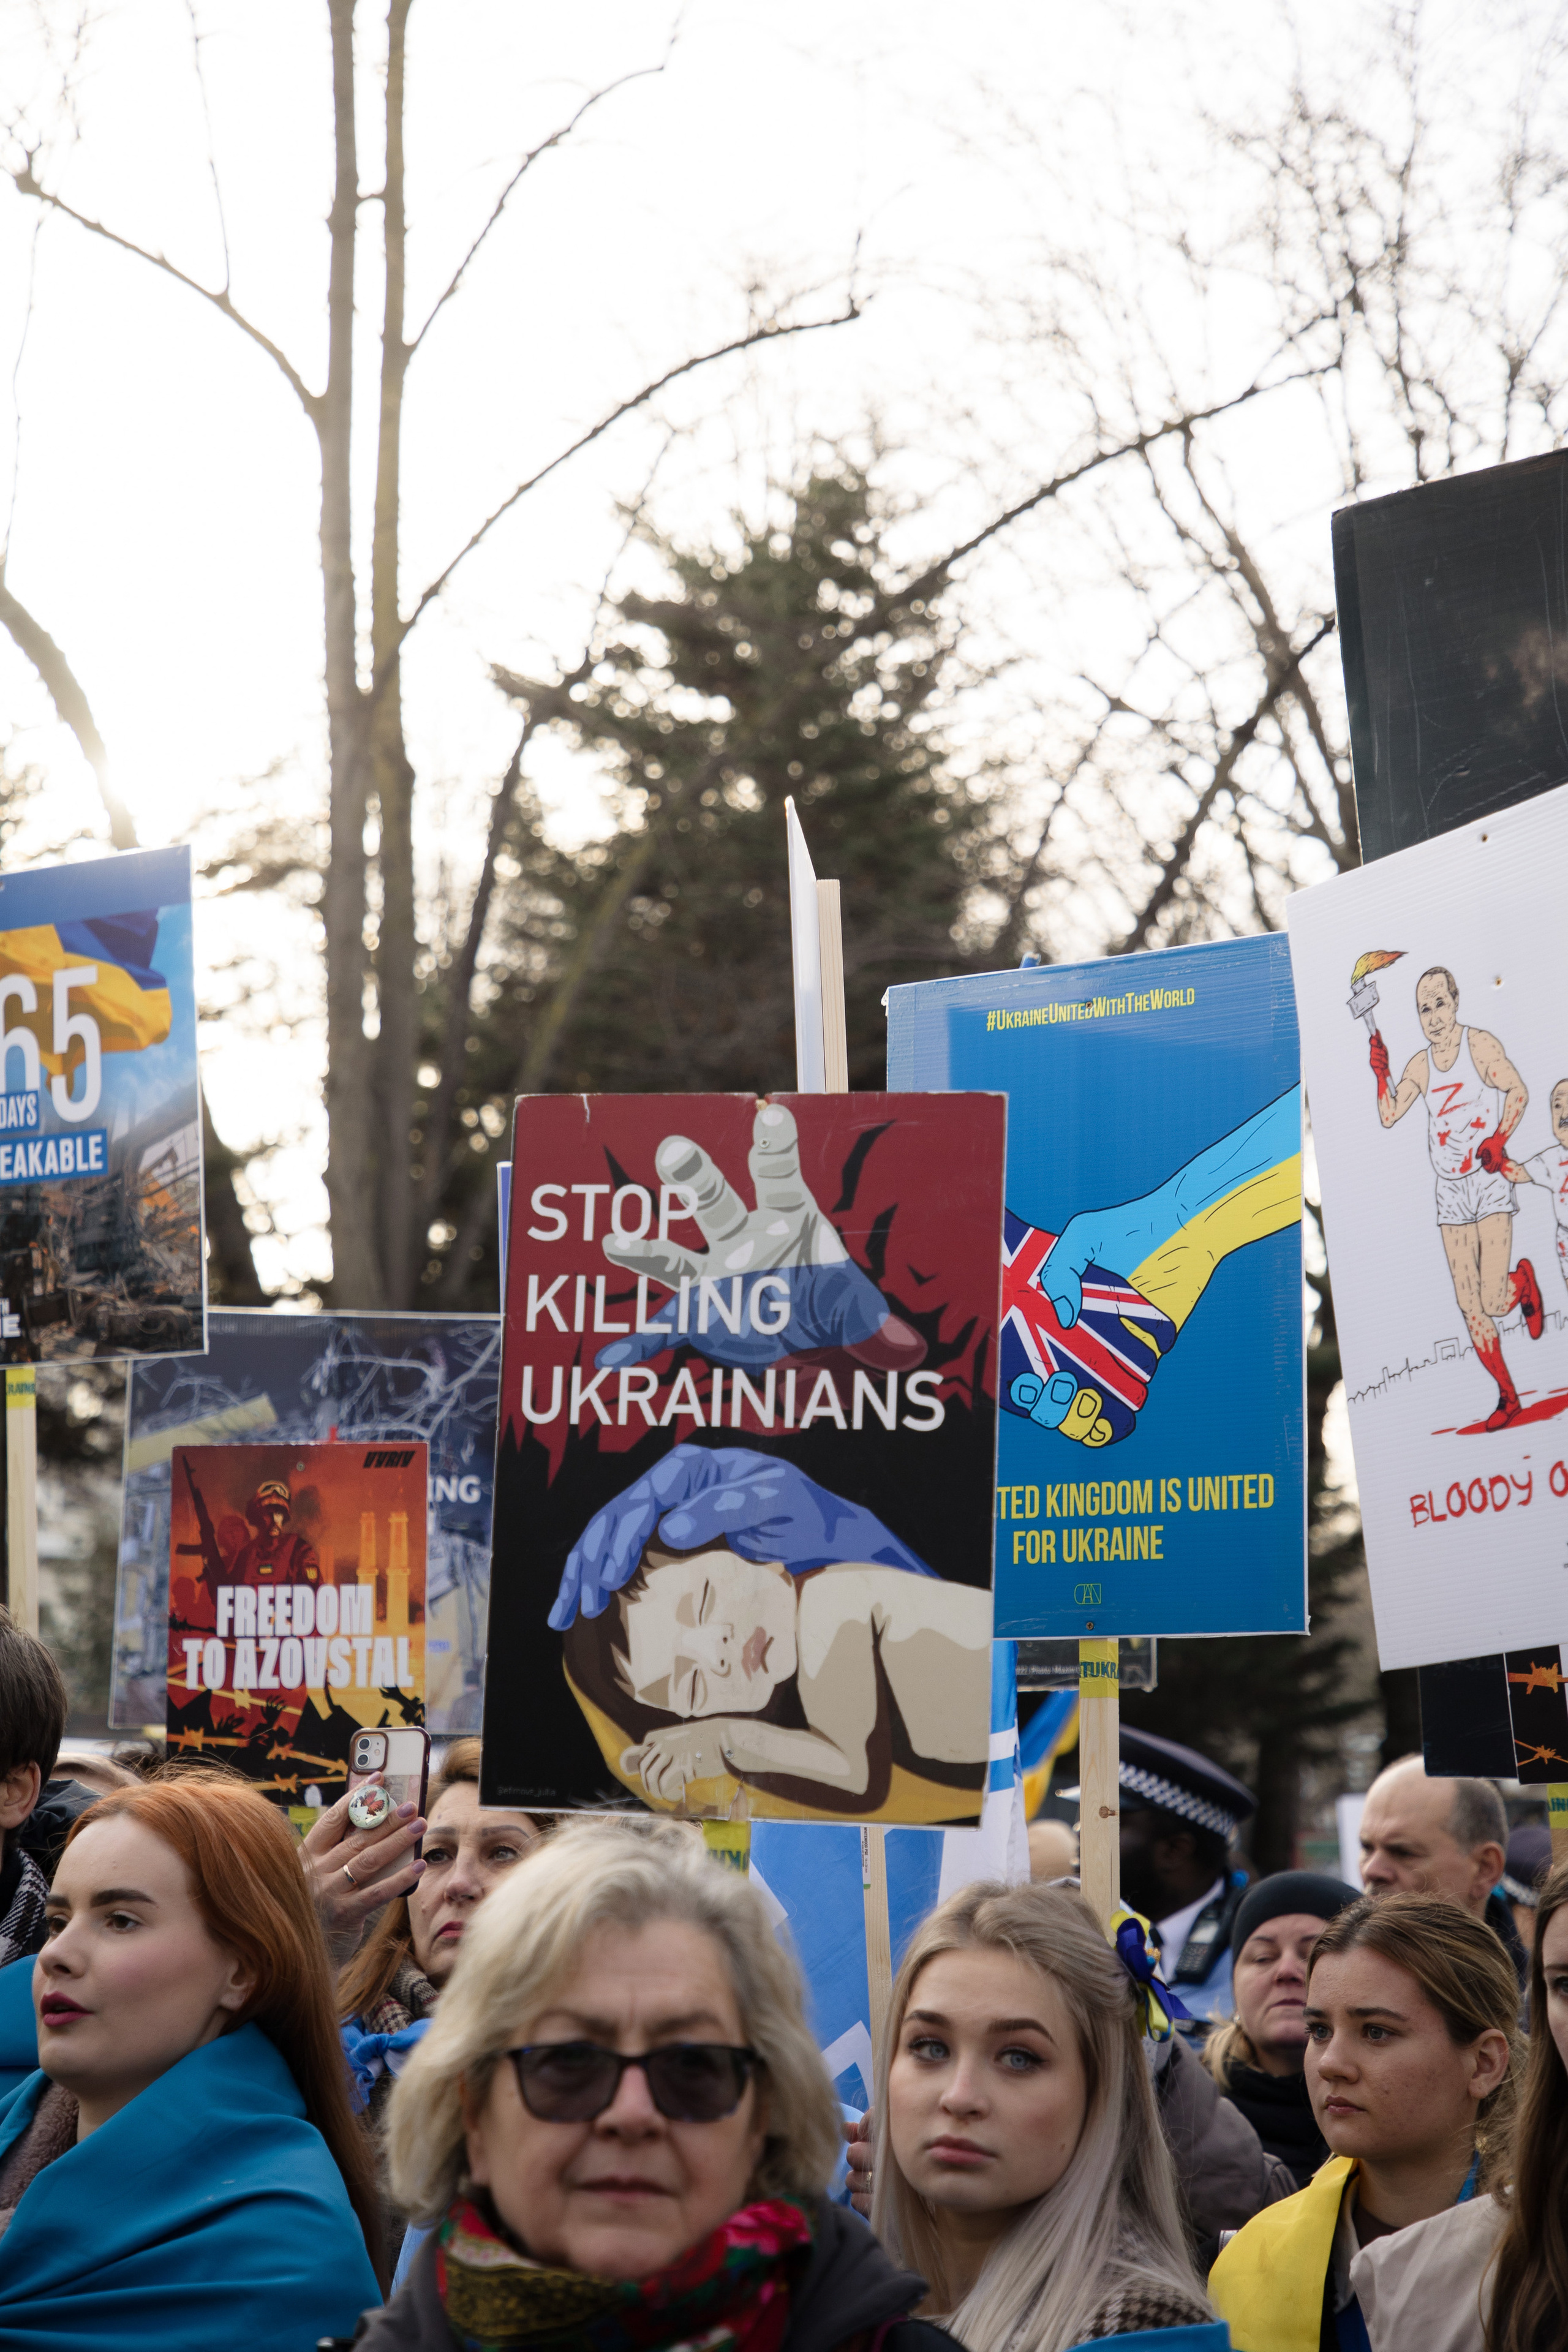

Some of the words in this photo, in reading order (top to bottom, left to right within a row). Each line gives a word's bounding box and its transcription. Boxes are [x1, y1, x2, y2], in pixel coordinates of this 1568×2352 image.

[527, 1183, 699, 1242] STOP
[526, 1274, 791, 1336] KILLING
[521, 1365, 946, 1432] UKRAINIANS
[997, 1485, 1039, 1520] TED
[1046, 1479, 1153, 1518] KINGDOM
[1160, 1477, 1182, 1513] IS
[1188, 1473, 1274, 1512] UNITED
[1410, 1470, 1533, 1528] BLOODY
[1013, 1530, 1057, 1565] FOR
[1063, 1525, 1164, 1563] UKRAINE
[216, 1583, 374, 1637] FREEDOM
[183, 1638, 227, 1690] TO
[232, 1636, 415, 1690] AZOVSTAL
